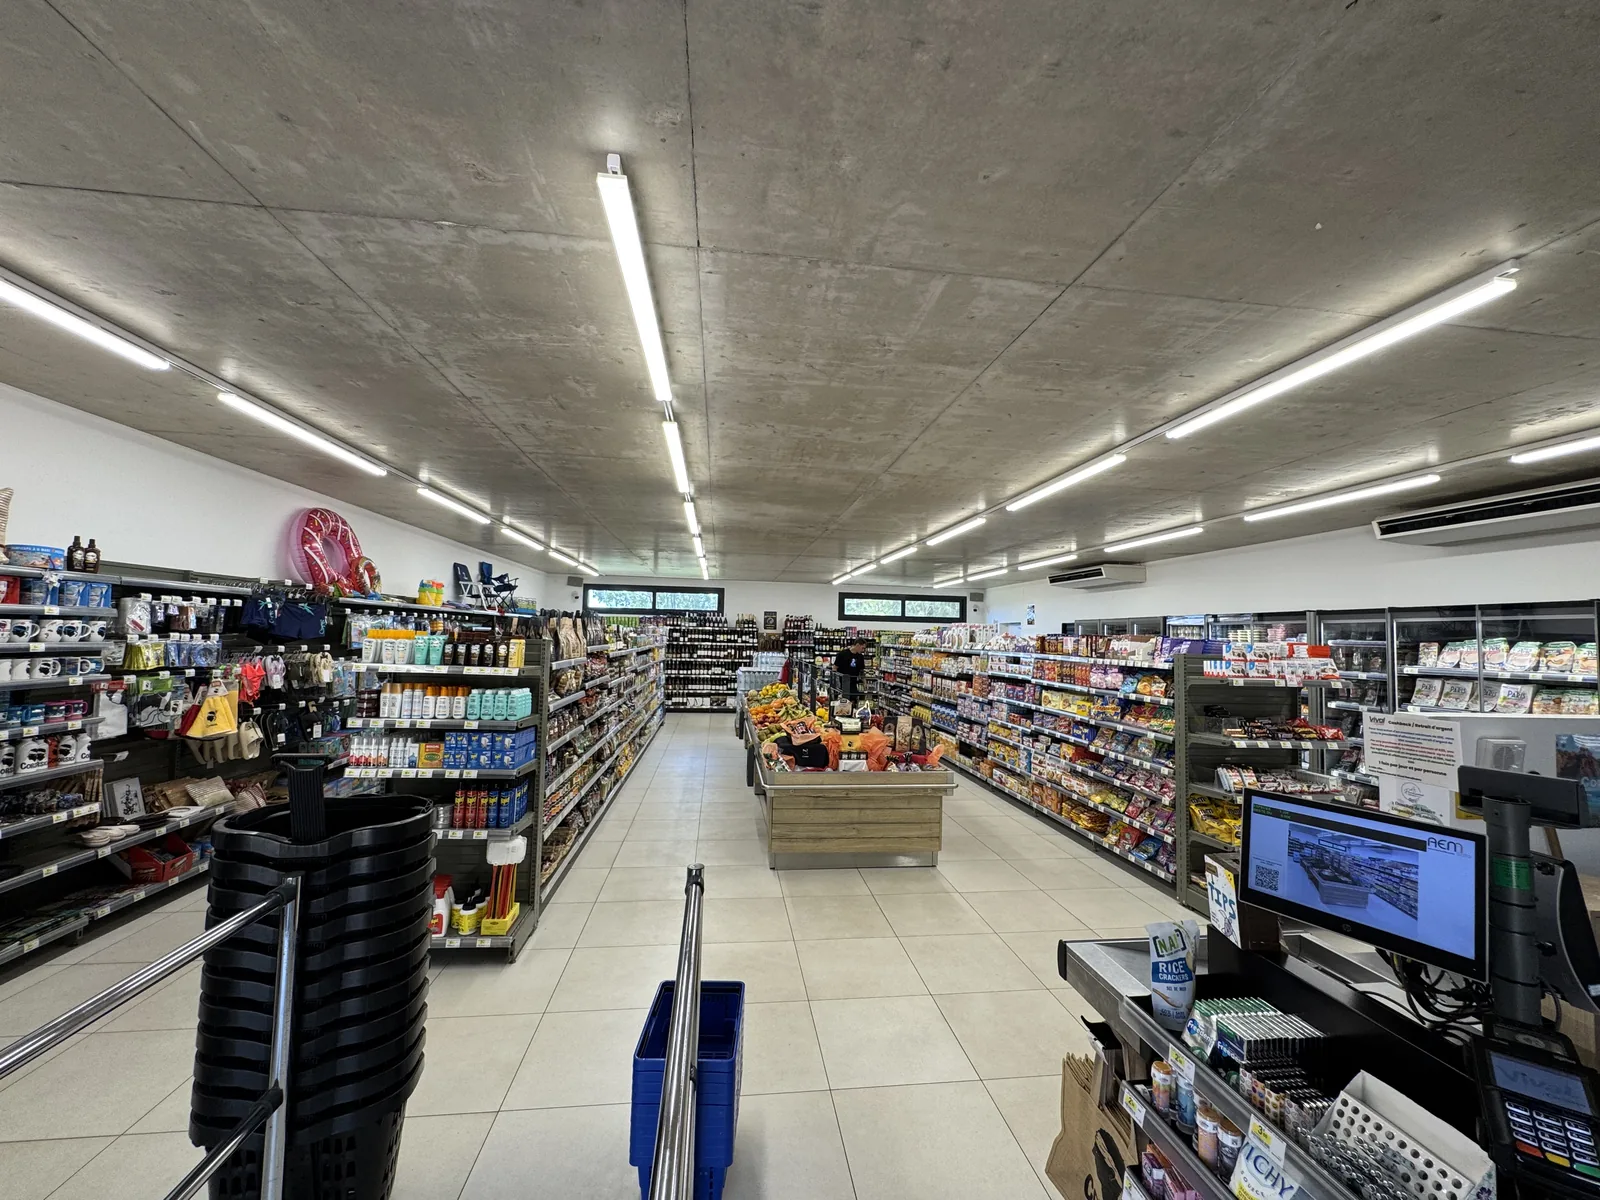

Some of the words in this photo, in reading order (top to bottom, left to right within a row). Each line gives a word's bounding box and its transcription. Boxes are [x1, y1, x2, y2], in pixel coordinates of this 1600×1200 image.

[1208, 881, 1237, 920] TIPS
[1159, 961, 1185, 974] RICE
[1159, 972, 1189, 981] CRACKERS
